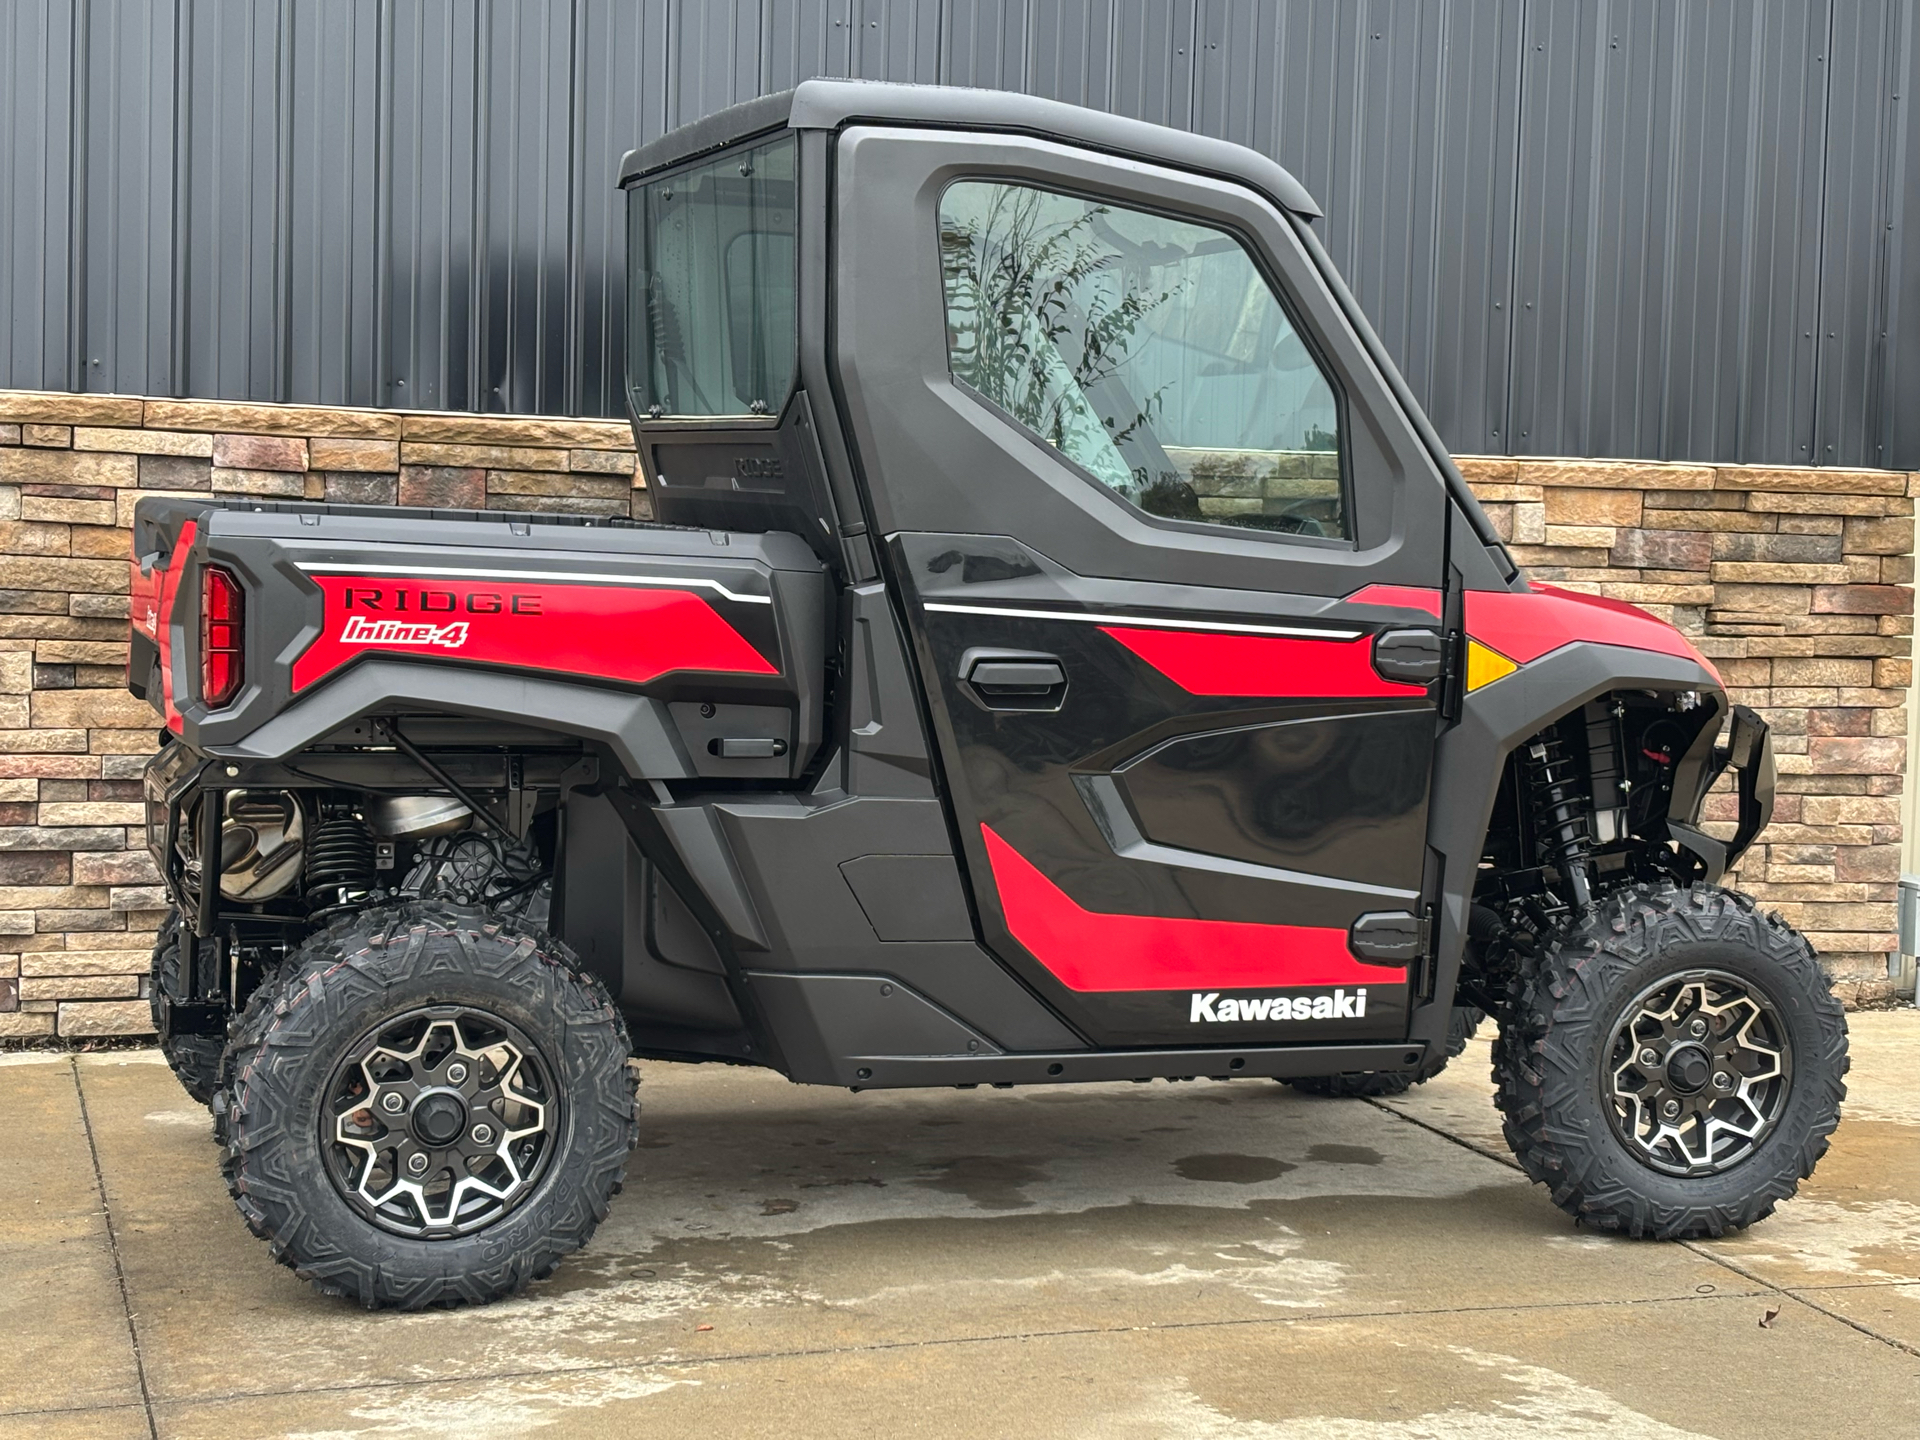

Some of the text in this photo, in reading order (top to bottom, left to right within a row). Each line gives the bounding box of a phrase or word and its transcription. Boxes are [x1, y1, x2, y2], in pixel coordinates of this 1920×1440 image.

[733, 457, 784, 478] RIDGE
[345, 588, 543, 615] RIDGE
[340, 616, 469, 647] Inline-4
[1190, 988, 1367, 1023] Kawasaki
[482, 1175, 573, 1261] DURO
